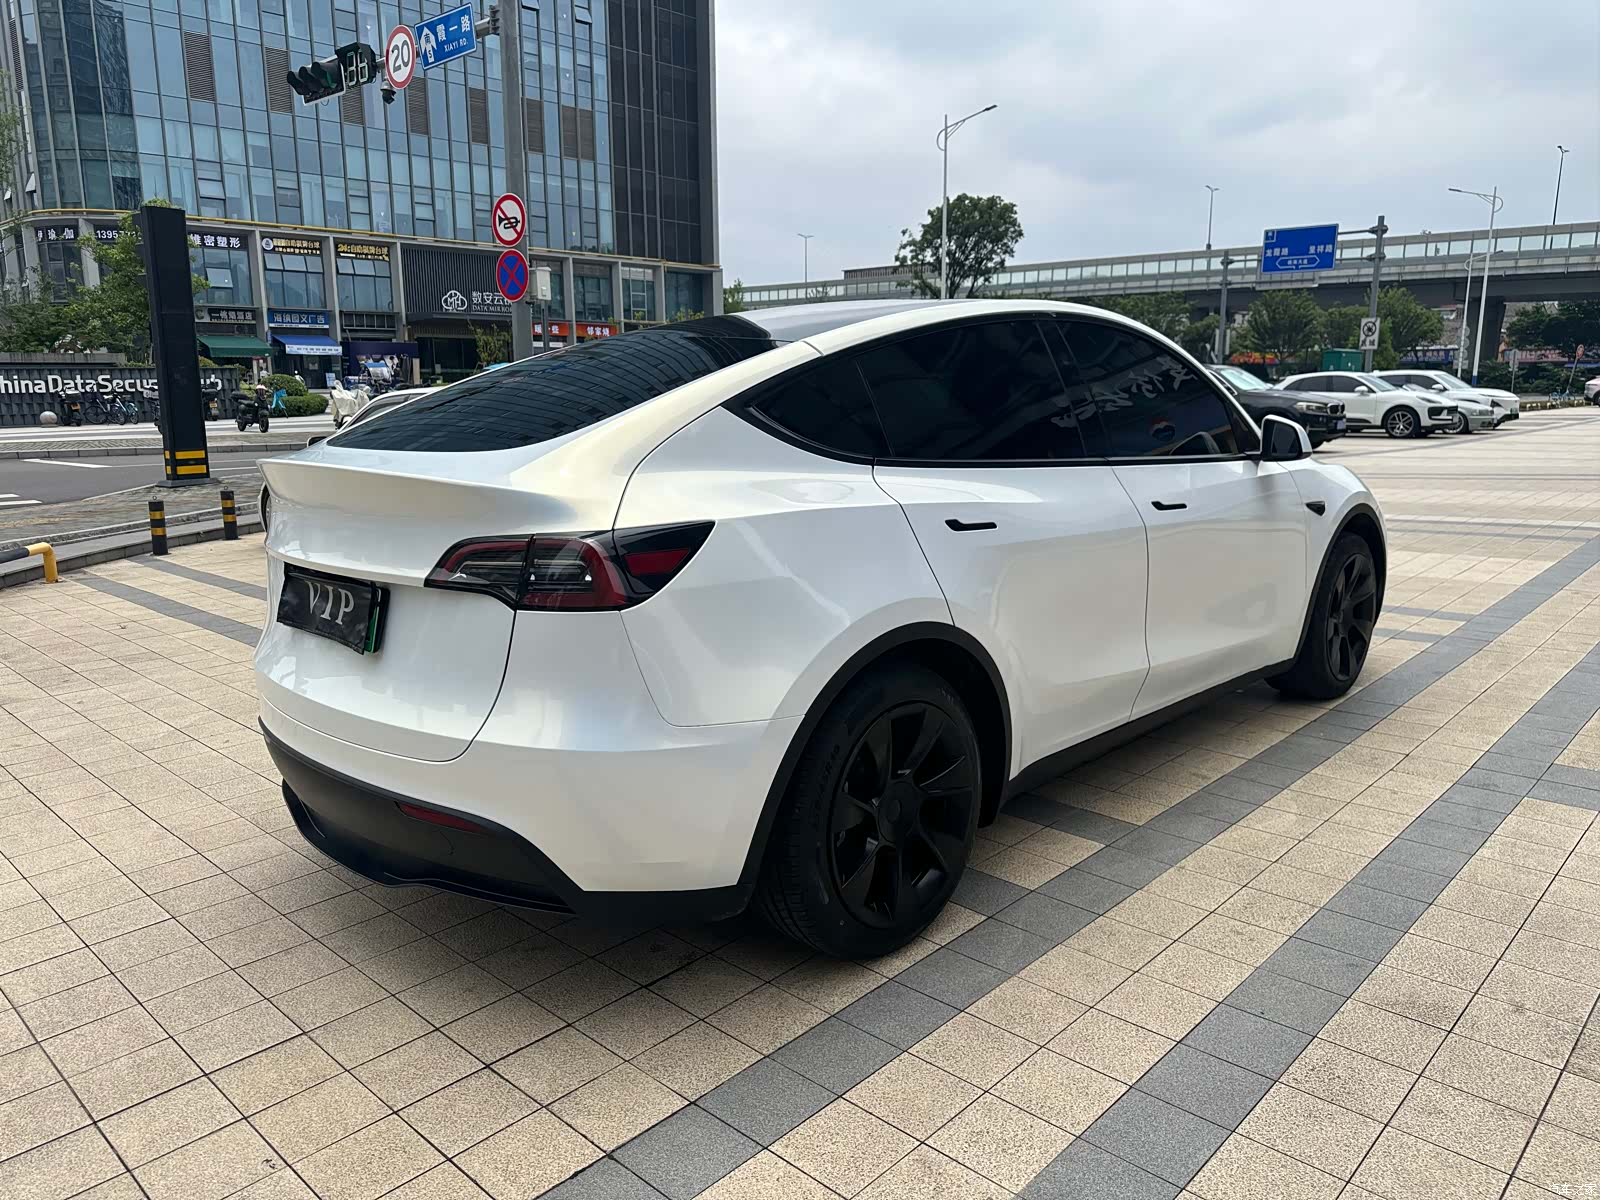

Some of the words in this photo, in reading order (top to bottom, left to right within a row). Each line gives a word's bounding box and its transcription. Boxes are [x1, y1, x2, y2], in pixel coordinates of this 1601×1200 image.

[436, 15, 471, 42] 霞一路
[392, 40, 411, 74] 20
[444, 41, 459, 52] XIAYI
[459, 38, 469, 48] RD.
[305, 580, 355, 625] VIP
